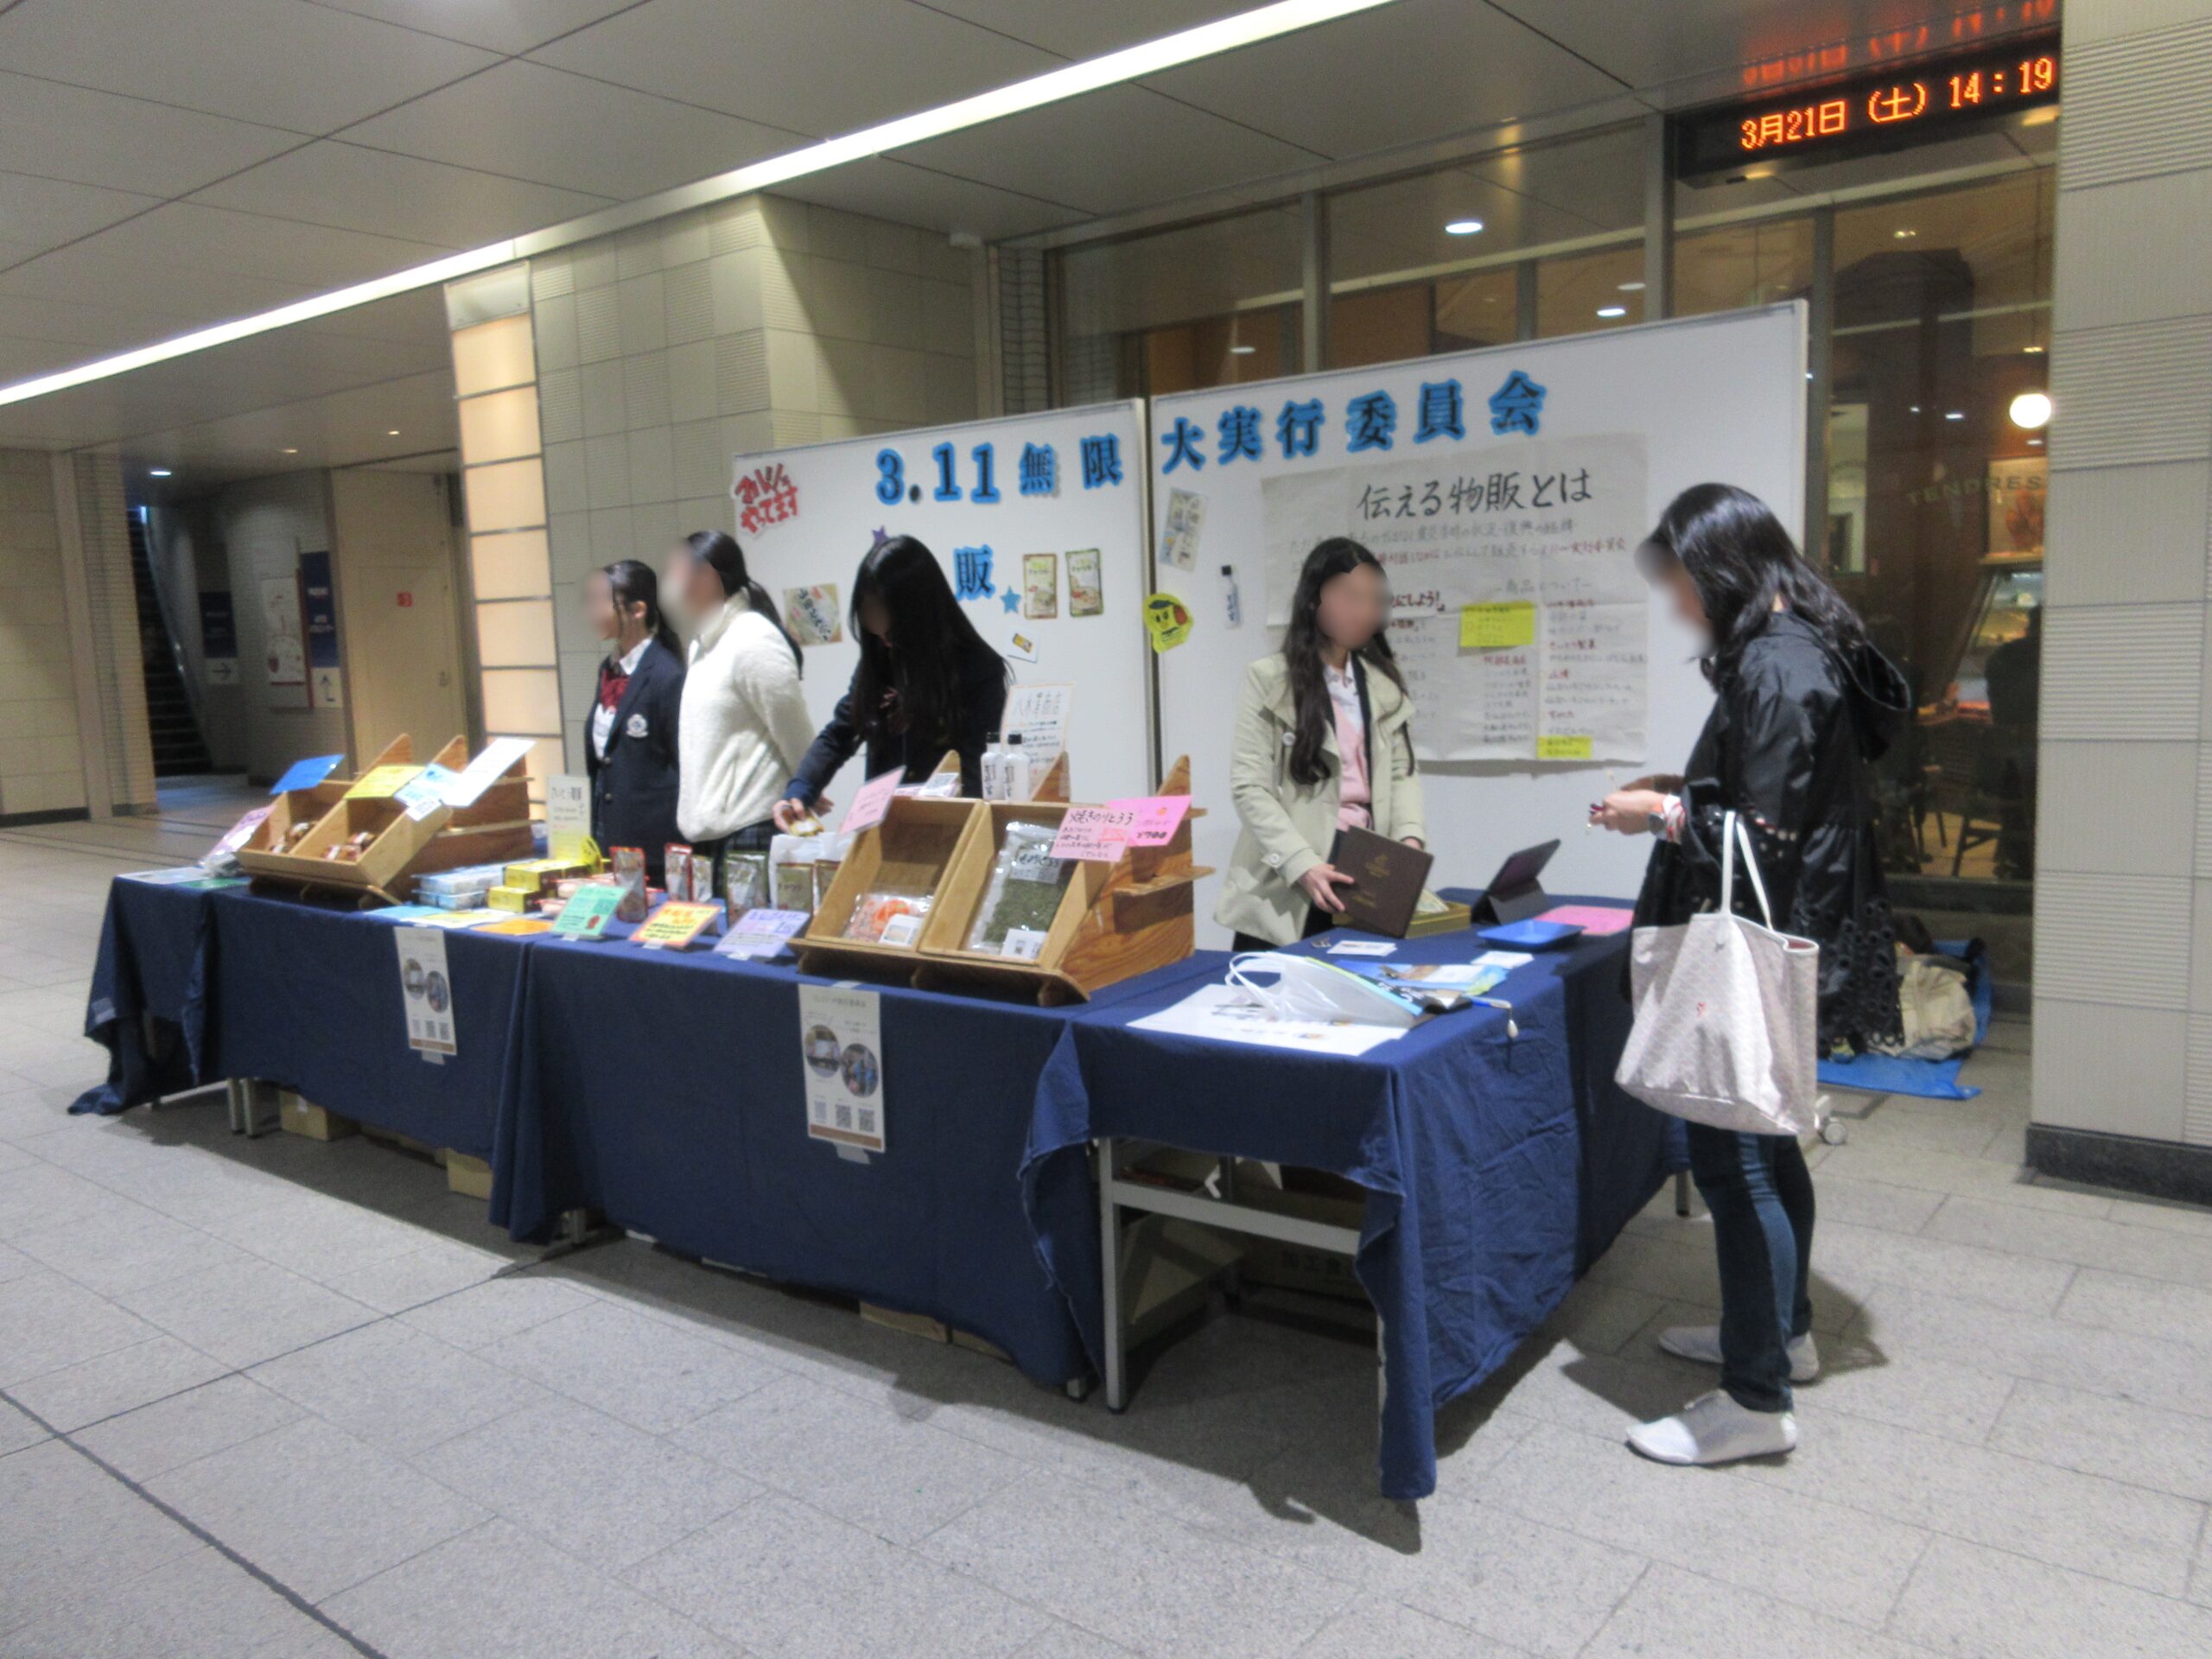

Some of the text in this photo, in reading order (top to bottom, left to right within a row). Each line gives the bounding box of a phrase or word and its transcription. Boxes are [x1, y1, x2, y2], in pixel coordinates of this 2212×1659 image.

[1740, 100, 1847, 150] 3月21日
[1160, 370, 1548, 474] 大実行委員会
[1356, 467, 1592, 520] 伝える物販とは
[953, 544, 995, 601] 販
